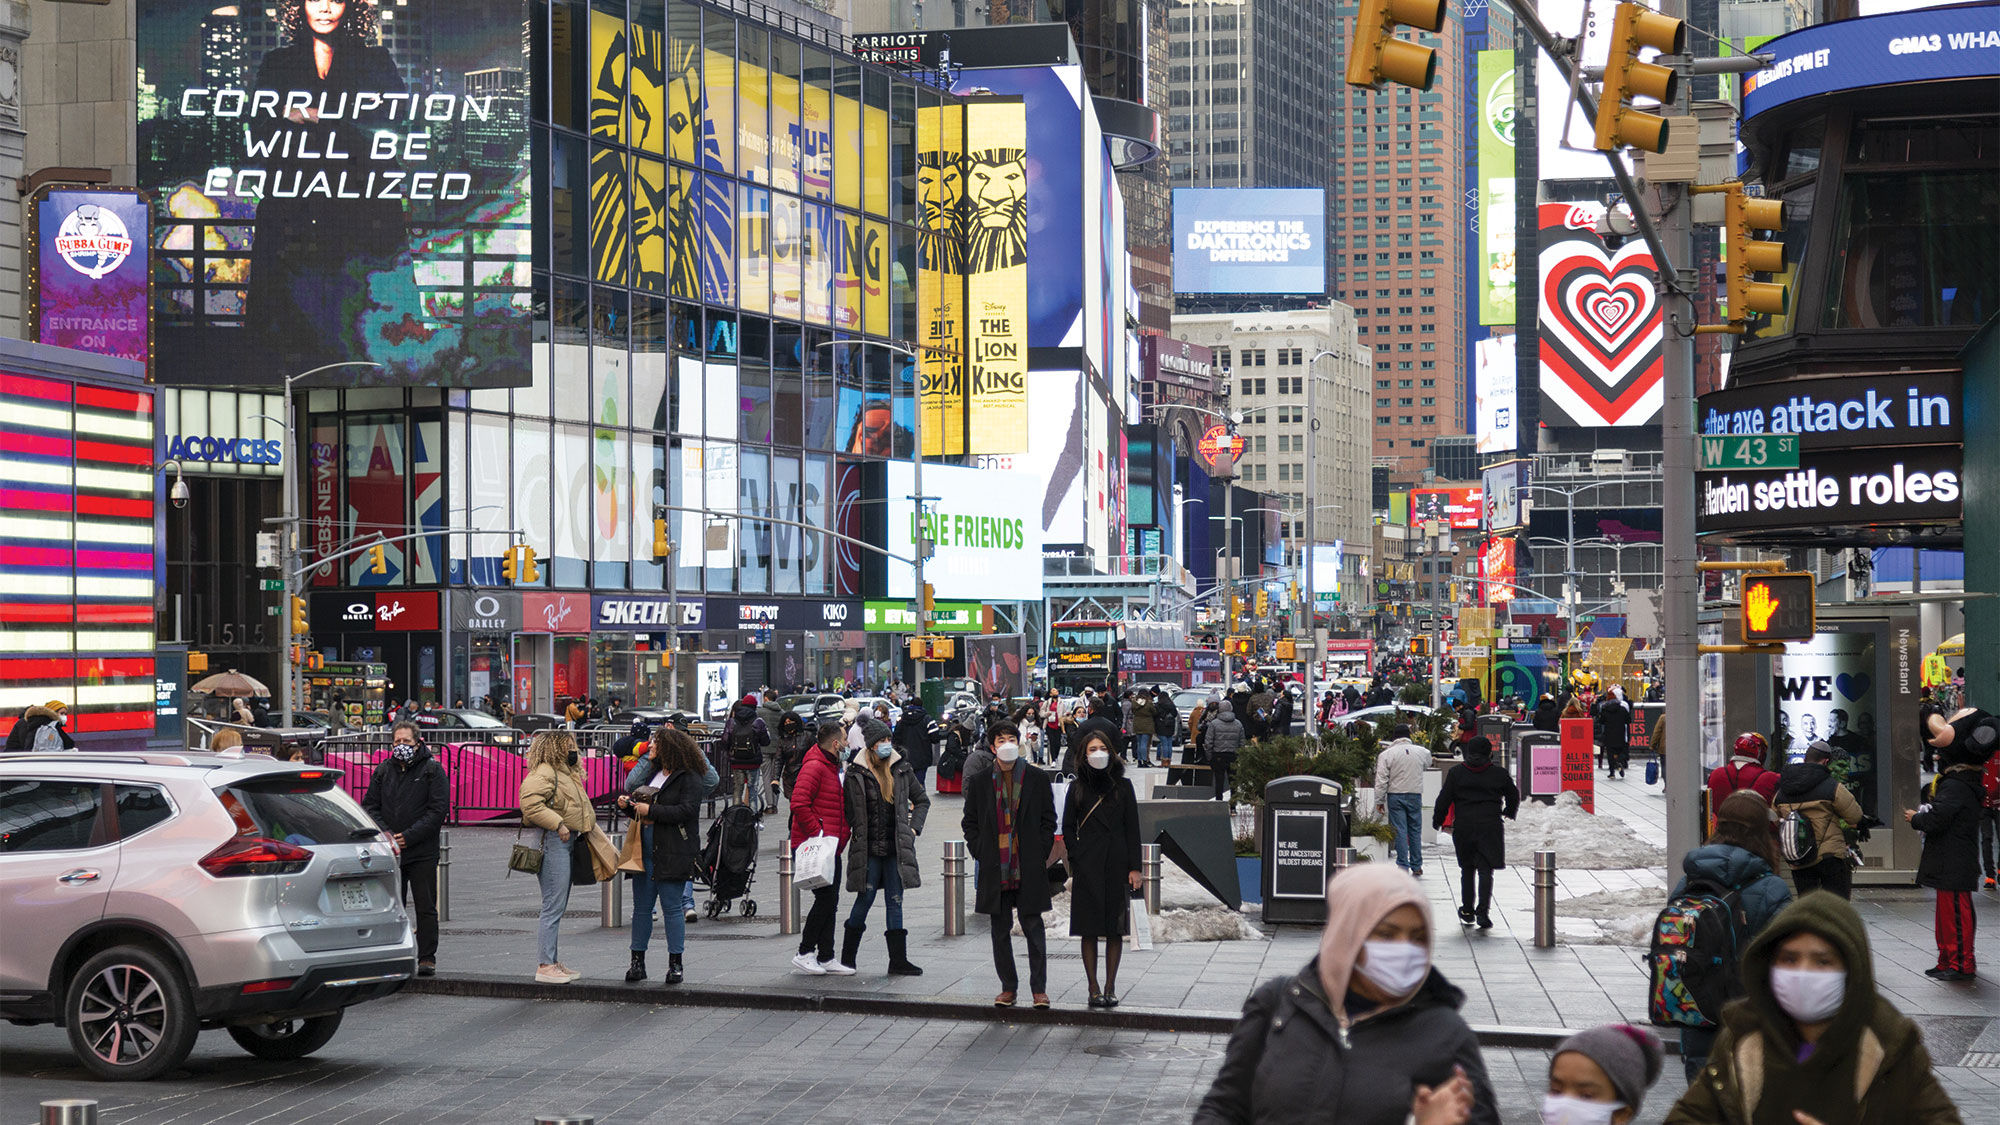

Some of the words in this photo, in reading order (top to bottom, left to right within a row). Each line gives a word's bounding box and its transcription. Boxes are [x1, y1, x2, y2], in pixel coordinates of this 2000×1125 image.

[853, 34, 928, 47] ARRIOTT
[1888, 34, 1942, 56] GMA3
[1947, 30, 2000, 50] WHA
[1814, 48, 1831, 66] ET
[180, 88, 492, 122] CORRUPTION
[244, 130, 349, 159] WILL
[370, 130, 432, 160] BE
[203, 167, 471, 200] EQUALIZED
[1194, 220, 1275, 233] EXPERIENCE
[1277, 220, 1304, 233] THE
[58, 238, 96, 250] BUBBA
[98, 237, 130, 252] GUMP
[1187, 233, 1311, 250] DAKTRONICS
[1209, 249, 1289, 262] DIFFERENCE
[49, 317, 138, 331] ENTRANCE
[980, 319, 1010, 333] THE
[80, 335, 106, 348] ON
[974, 337, 1017, 363] LION
[972, 365, 1023, 396] KING
[1704, 408, 1731, 434] after
[1732, 408, 1764, 434] axe
[1770, 389, 1895, 434] attack
[1908, 387, 1951, 427] in
[165, 434, 282, 465] IACOMCBS
[1704, 439, 1725, 466] W
[1733, 438, 1768, 466] 43
[1778, 437, 1794, 452] ST
[317, 443, 332, 510] NEWS
[1704, 476, 1750, 516] Harden
[1753, 468, 1840, 511] settle
[1849, 463, 1960, 506] roles
[318, 514, 332, 558] CBS
[910, 511, 949, 546] LNE
[954, 514, 1024, 550] FRIENDS
[342, 613, 374, 621] OAKLEY
[376, 600, 406, 621] Ray-Ban
[543, 596, 573, 630] Ray-Ban
[599, 600, 704, 625] SKECHRS
[823, 603, 848, 620] KIKO
[932, 611, 938, 620] W
[940, 611, 950, 619] 44
[468, 618, 506, 629] OAKLEY
[207, 623, 266, 646] 1515
[1899, 628, 1910, 694] Newsstand
[707, 670, 718, 682] WE
[1773, 676, 1833, 701] WE
[1634, 709, 1645, 719] IN
[1629, 736, 1650, 747] ARE
[1565, 752, 1579, 760] ALL
[1581, 752, 1590, 760] IN
[1566, 763, 1591, 771] TIMES
[1562, 773, 1593, 781] SQUARE
[1278, 841, 1287, 849] WE
[1287, 841, 1298, 849] ARE
[1278, 850, 1290, 858] OUR
[1290, 850, 1323, 858] ANCESTORS'
